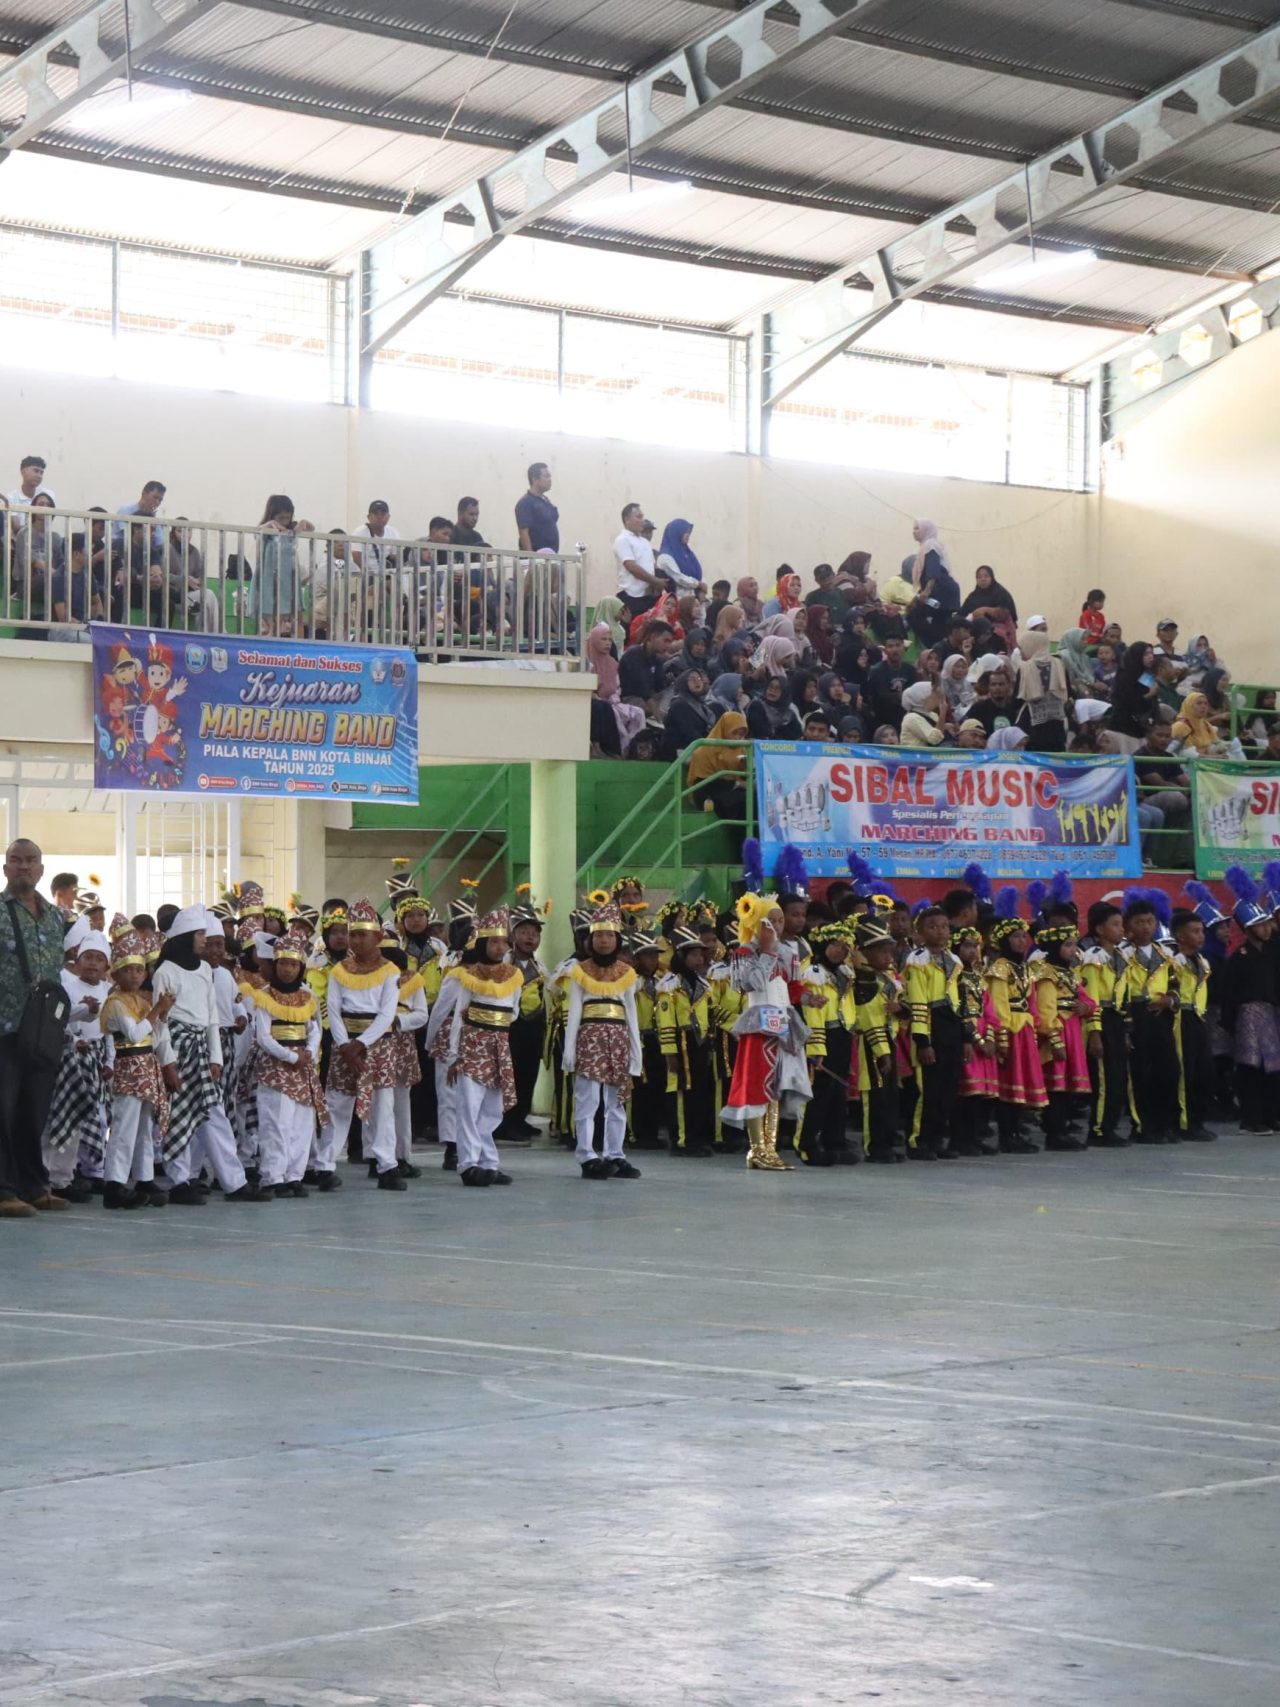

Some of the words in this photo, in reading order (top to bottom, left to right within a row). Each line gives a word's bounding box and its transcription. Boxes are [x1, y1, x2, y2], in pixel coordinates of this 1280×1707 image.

[238, 650, 291, 669] Selamat
[292, 655, 317, 670] dan
[318, 655, 363, 673] Sukses
[240, 670, 362, 708] Kejuaran
[200, 703, 328, 746] MARCHING
[333, 711, 398, 750] BAND
[203, 744, 239, 758] PIALA
[242, 746, 288, 761] KEPALA
[291, 748, 318, 762] BNN
[320, 751, 352, 765] KOTA
[354, 752, 392, 767] BINJAI
[263, 760, 305, 775] TAHUN
[306, 763, 335, 777] 2025
[830, 762, 936, 807] SIBAL
[945, 767, 1060, 811] MUSIC
[1250, 781, 1280, 815] SI
[891, 808, 938, 821] Spesialis
[861, 823, 979, 842] MARCHING
[983, 827, 1046, 843] BAND
